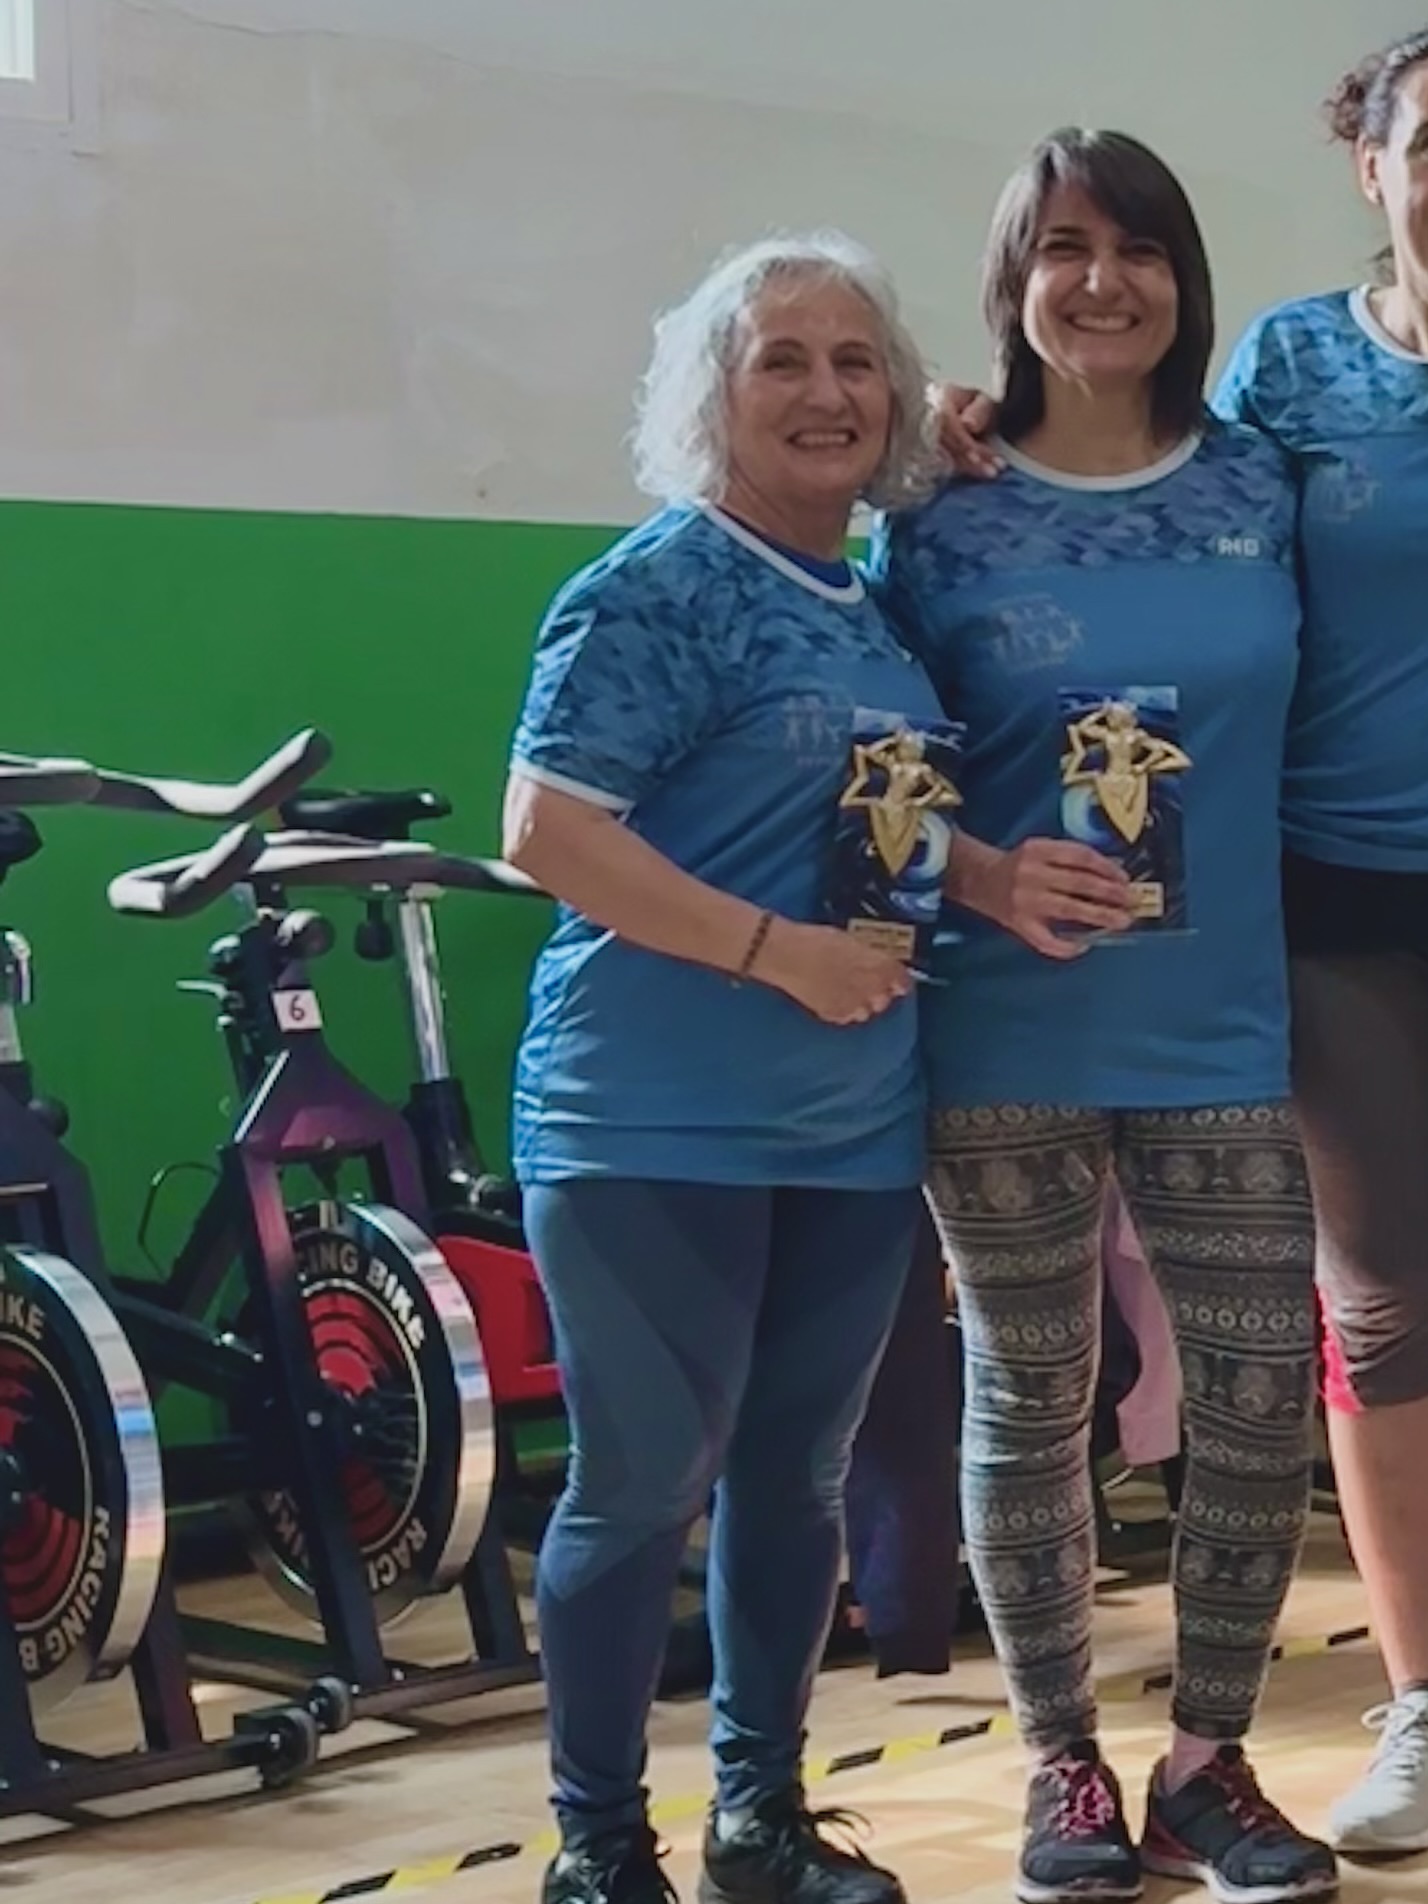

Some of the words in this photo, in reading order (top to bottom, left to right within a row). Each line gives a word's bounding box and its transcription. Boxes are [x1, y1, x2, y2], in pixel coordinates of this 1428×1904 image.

[289, 995, 305, 1021] 6
[366, 1256, 425, 1350] BIKE
[45, 1505, 111, 1662] RACING
